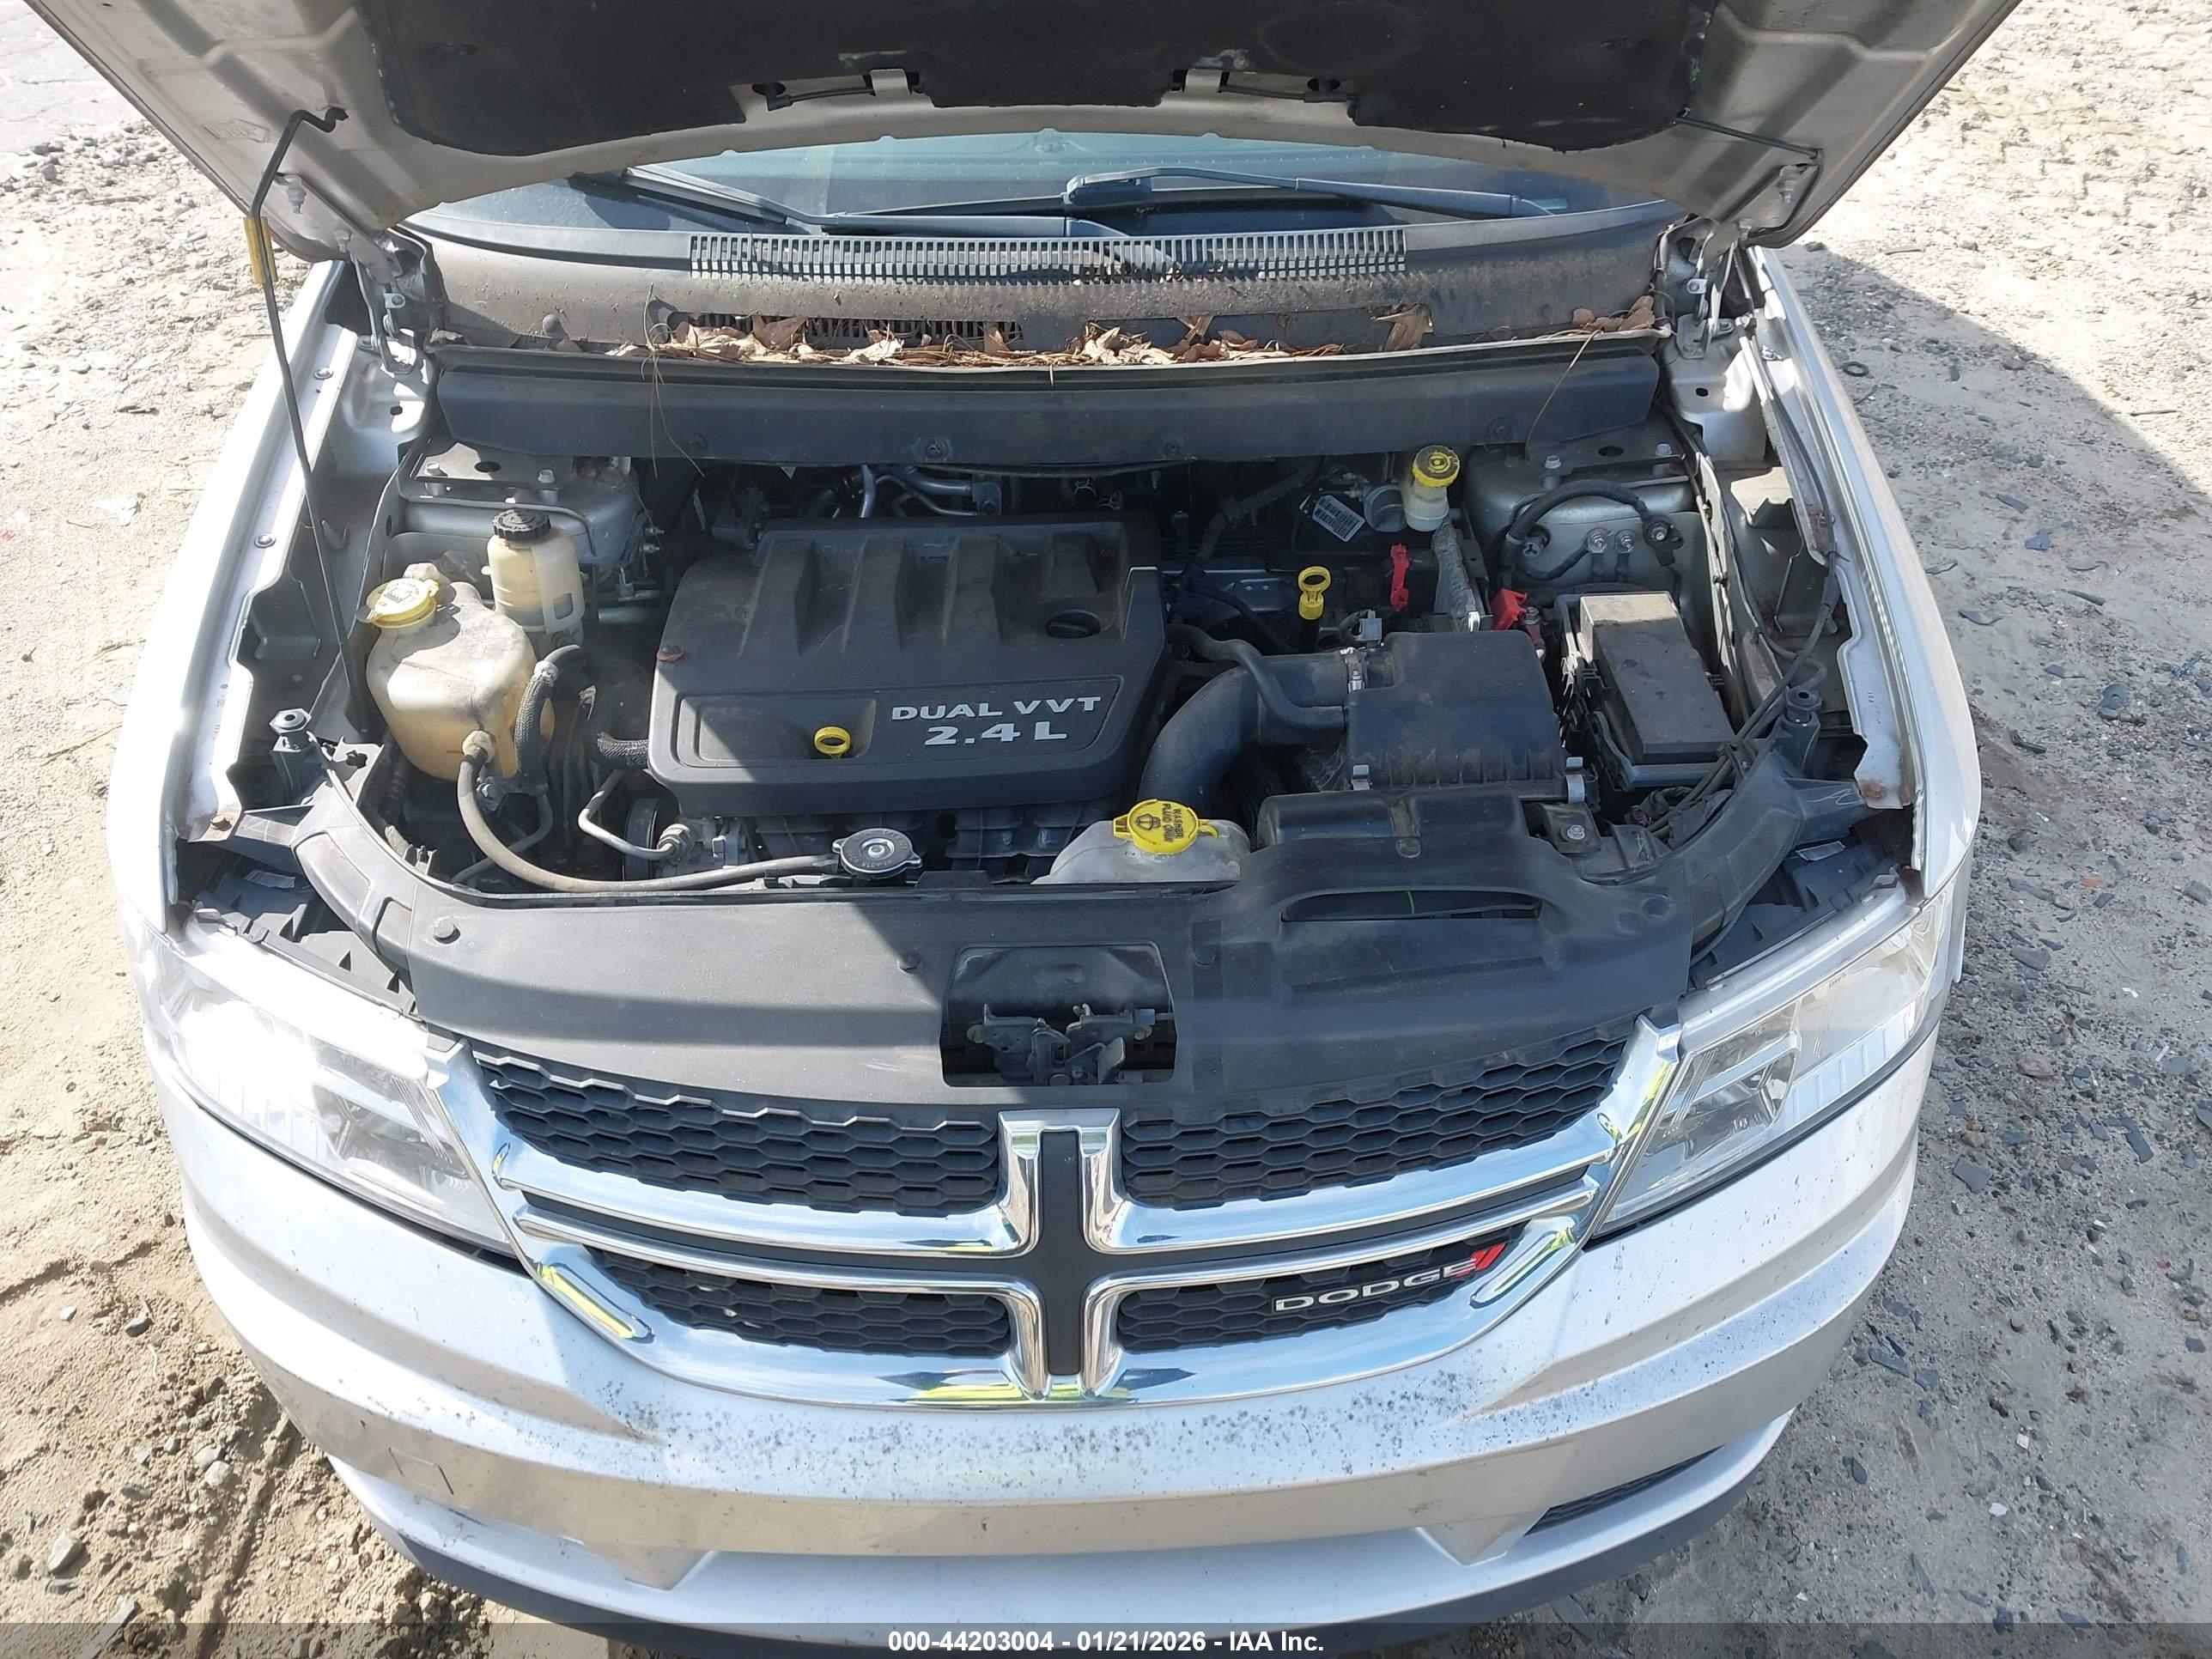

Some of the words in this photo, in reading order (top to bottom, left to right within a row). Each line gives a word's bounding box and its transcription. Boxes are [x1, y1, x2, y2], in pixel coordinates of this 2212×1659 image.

[891, 702, 1003, 720] DUAL
[1013, 696, 1102, 715] VVT
[925, 723, 1021, 746] 2.4
[1034, 720, 1067, 741] L
[1275, 1258, 1477, 1312] DODGE
